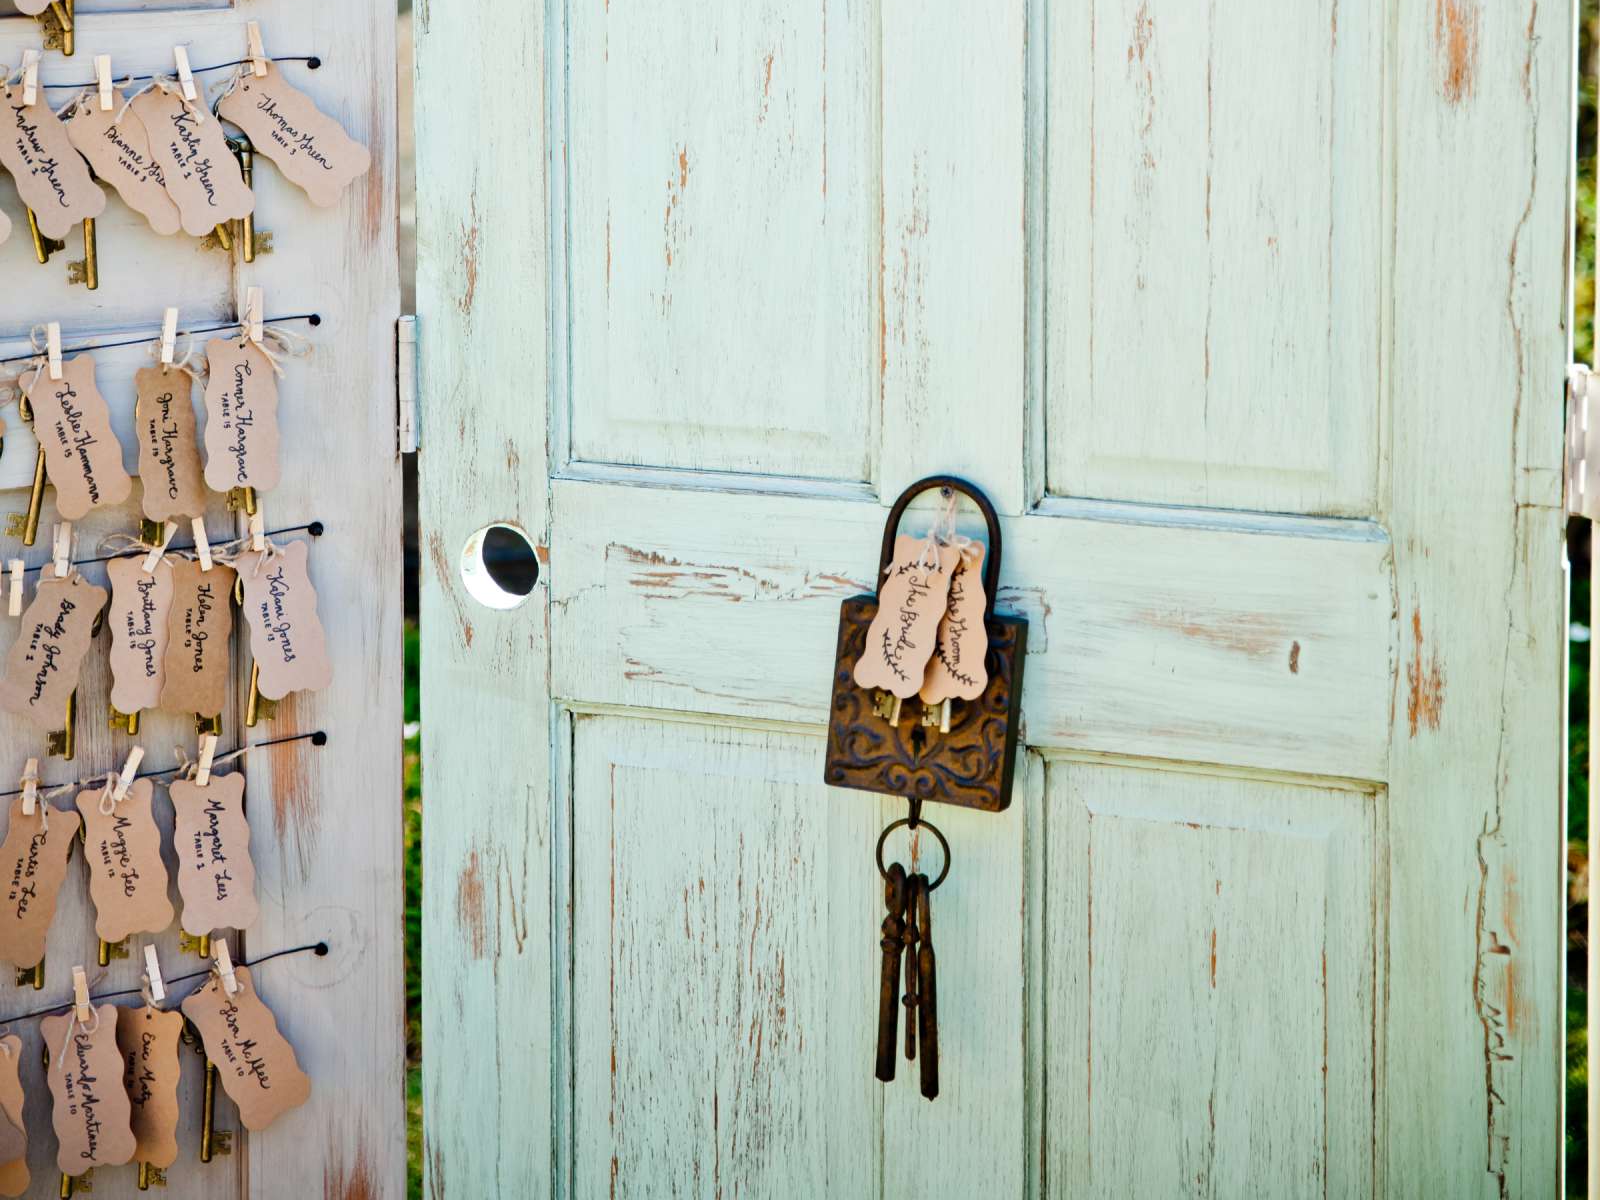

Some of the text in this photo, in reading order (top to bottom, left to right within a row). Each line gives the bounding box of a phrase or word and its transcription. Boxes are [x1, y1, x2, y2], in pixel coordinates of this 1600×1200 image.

[15, 137, 34, 165] TABLE
[103, 125, 144, 166] Dianne
[256, 92, 333, 171] Thomas Green
[271, 130, 289, 149] TABLE
[117, 155, 140, 176] TABLE
[169, 142, 187, 169] TABLE
[38, 157, 70, 208] Green
[194, 156, 217, 207] Green
[55, 381, 83, 434] Leslie
[220, 392, 230, 418] TABLE
[55, 420, 69, 446] TABLE
[149, 418, 158, 444] TABLE
[155, 392, 179, 500] Joni Hargrave
[226, 411, 254, 483] Hargrave
[126, 610, 136, 638] TABLE
[135, 575, 157, 678] Brittany Jones
[184, 607, 193, 635] TABLE
[191, 583, 215, 673] Helen Jones
[260, 601, 272, 629] TABLE
[265, 565, 297, 663] Kalani Jones
[895, 576, 931, 661] The Bride
[949, 583, 968, 669] The Groom
[28, 597, 77, 707] Brady Johnson
[29, 623, 44, 651] TABLE
[193, 830, 204, 859] TABLE
[203, 798, 228, 865] Margaret
[11, 857, 24, 887] TABLE
[100, 839, 112, 865] TABLE
[110, 812, 140, 898] Maggie Lee
[16, 830, 48, 920] Curtis Lee
[219, 999, 240, 1039] Lisa
[140, 1032, 156, 1063] Eric
[220, 1038, 237, 1063] TABLE
[64, 1072, 75, 1100] TABLE
[68, 1088, 102, 1161] Martinez
